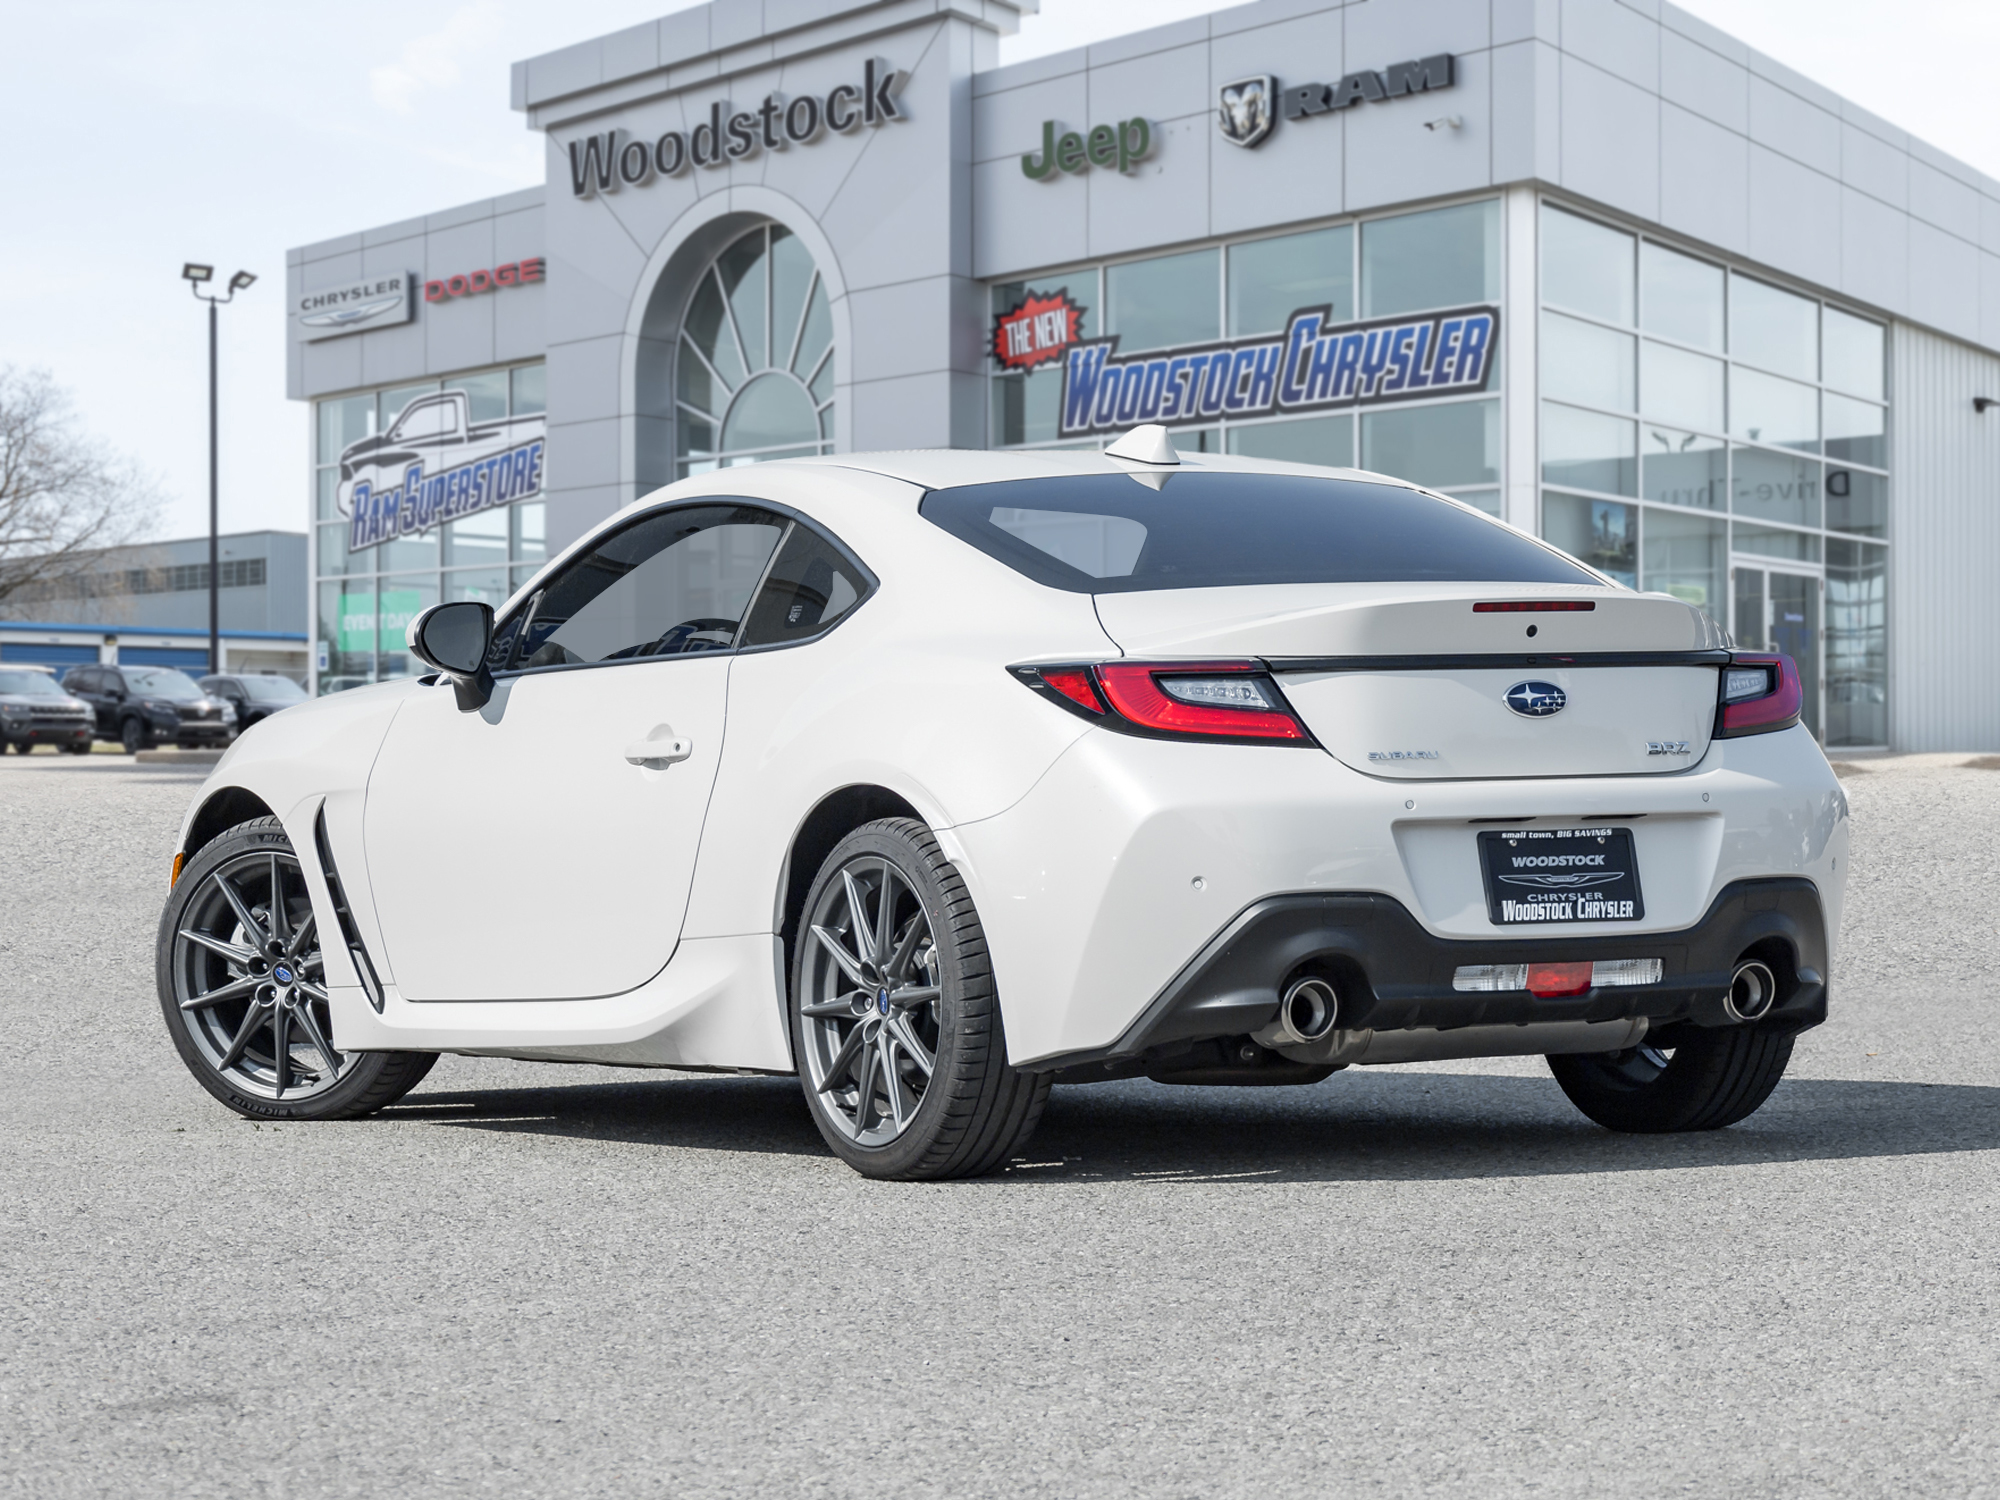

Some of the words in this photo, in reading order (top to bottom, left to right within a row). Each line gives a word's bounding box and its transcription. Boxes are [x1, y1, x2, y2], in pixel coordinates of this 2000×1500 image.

[1284, 52, 1455, 121] RAM
[567, 56, 904, 198] Woodstock
[1020, 115, 1154, 182] Jeep
[424, 256, 545, 303] DODGE
[300, 278, 402, 312] CHRYSLER
[1005, 320, 1031, 357] THE
[1032, 307, 1068, 347] NEW
[1063, 345, 1283, 432] WOODSTOCK
[1278, 311, 1493, 406] CHRYSLER
[1367, 750, 1439, 761] SUBARU
[1646, 741, 1691, 756] BRZ
[1501, 831, 1527, 839] small
[1528, 831, 1554, 839] town,
[1556, 830, 1572, 838] BIG
[1574, 828, 1612, 837] SAVINGS
[1511, 854, 1606, 868] WOODSTOCK
[1501, 900, 1573, 922] WOODSTOCK
[1576, 897, 1634, 919] CHRYSLER
[1527, 892, 1604, 902] CHRYSLER
[232, 1096, 289, 1117] MICHELIN
